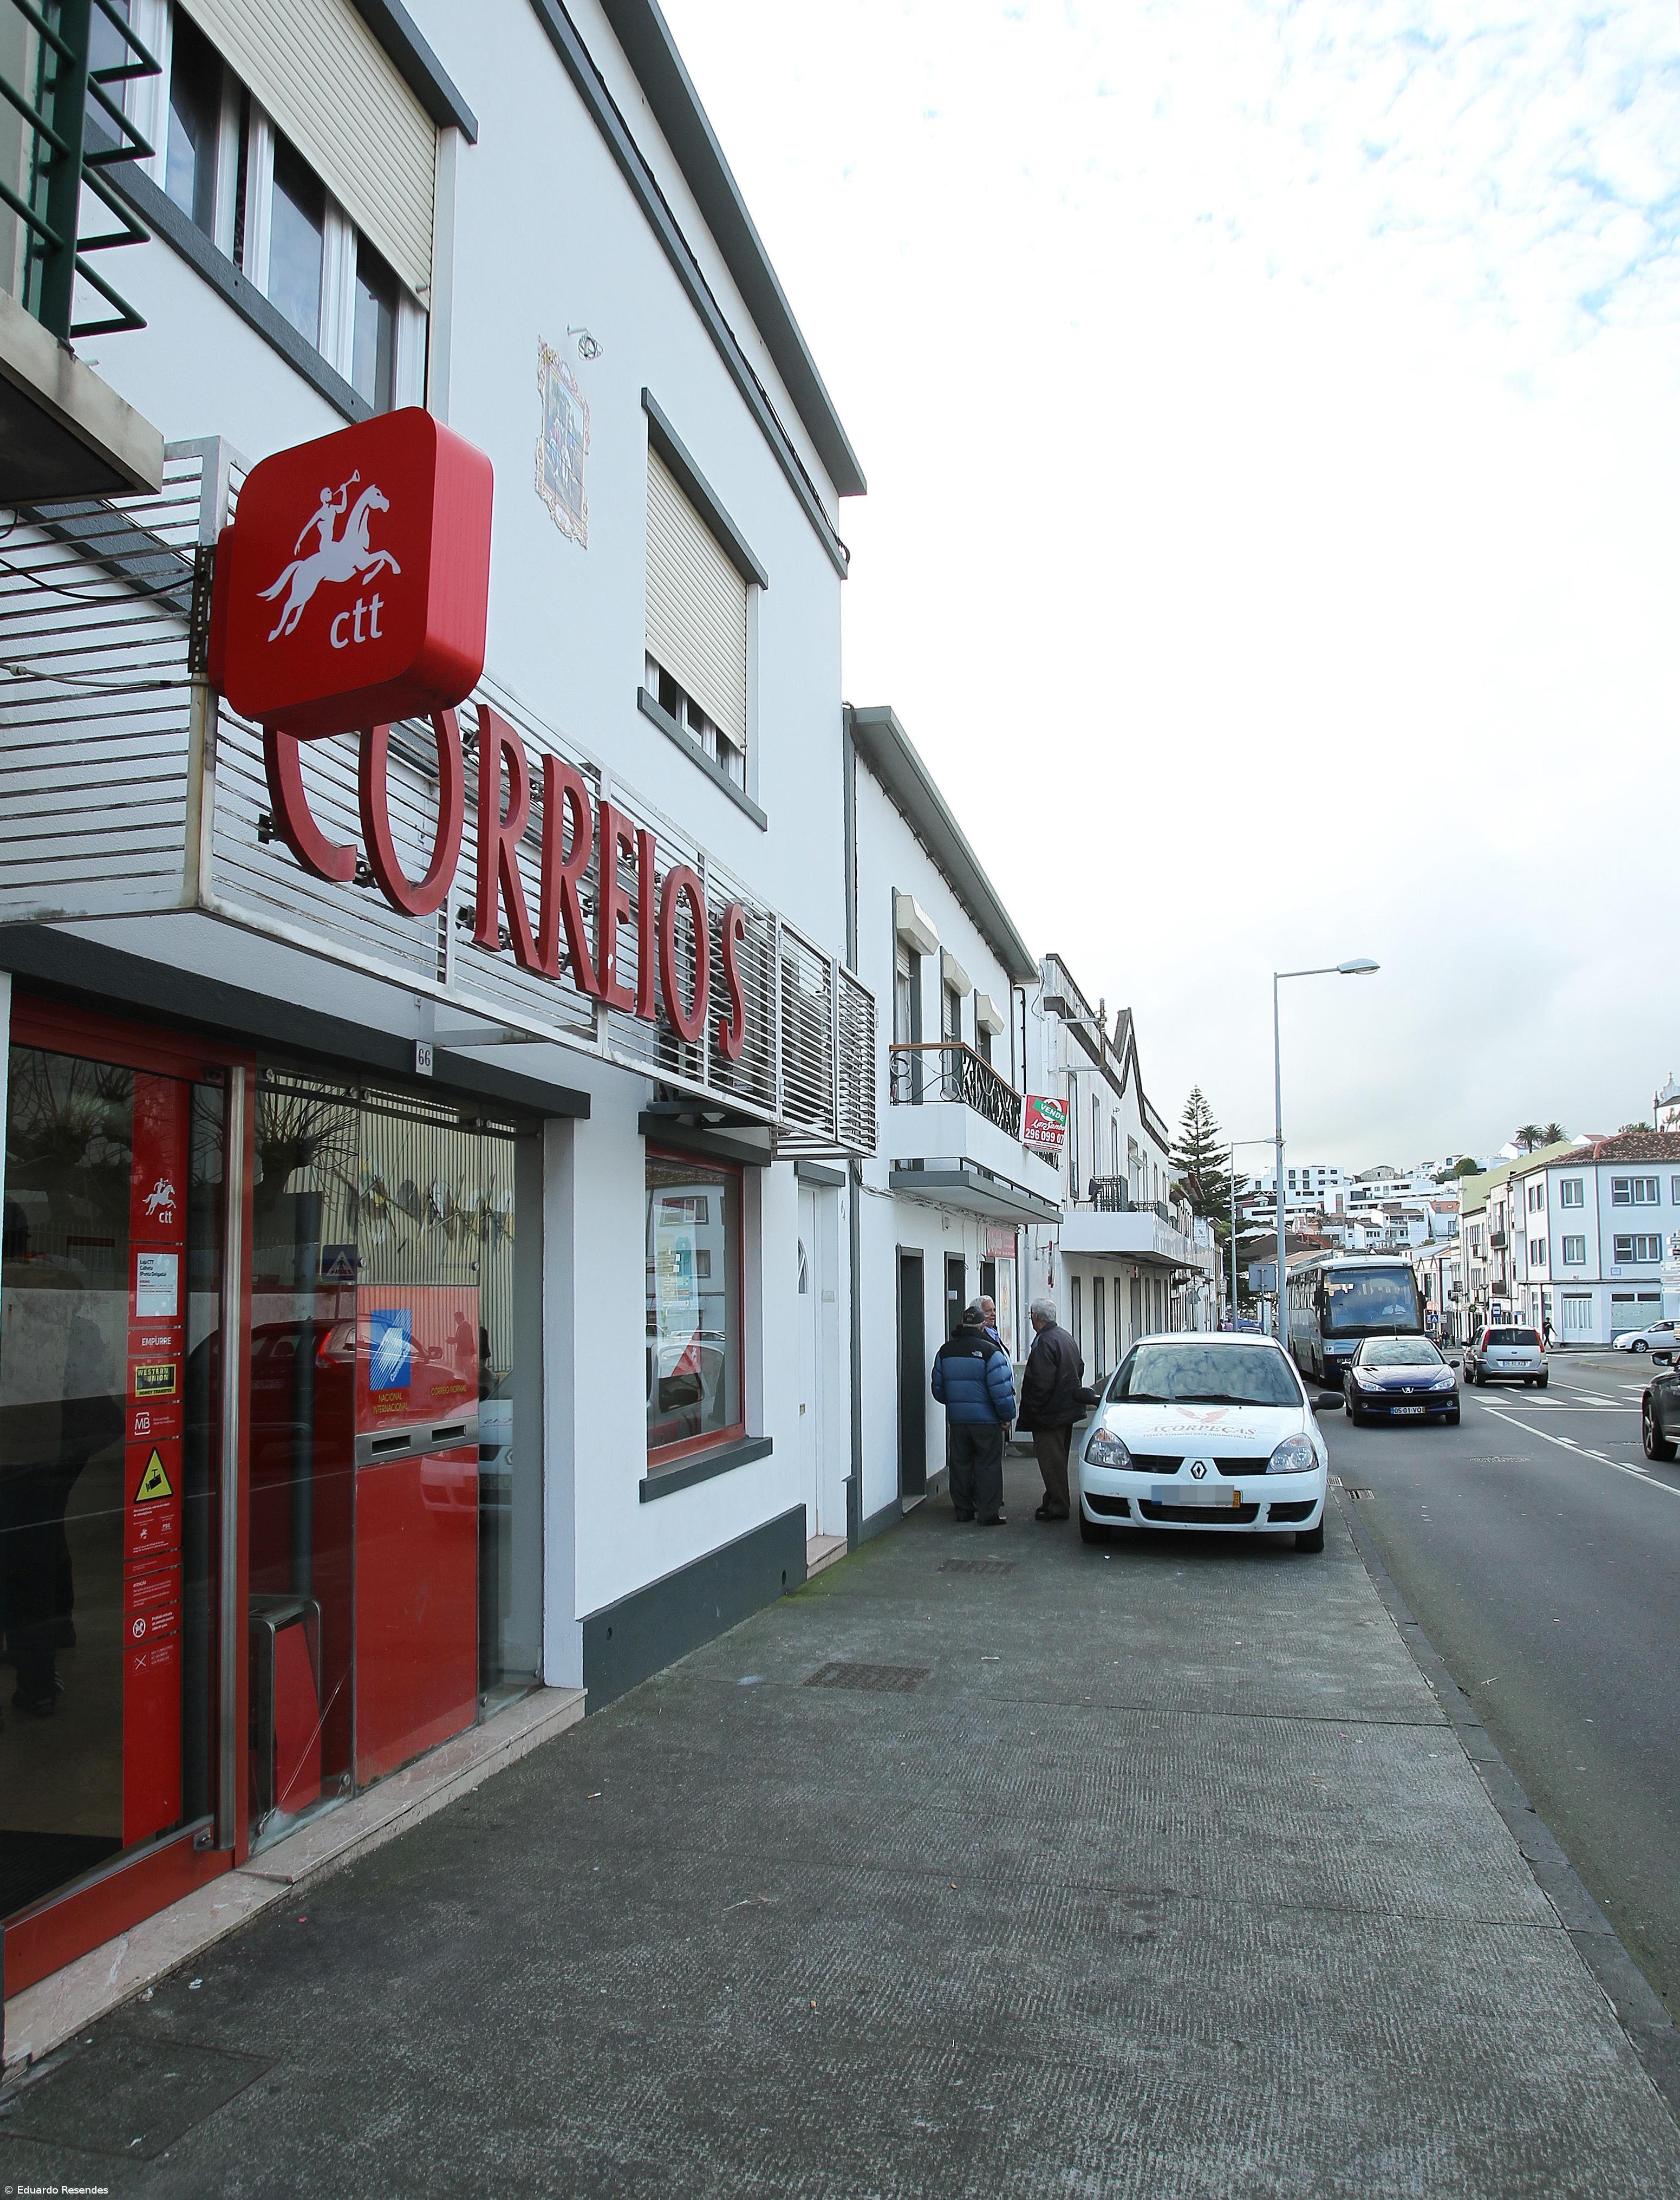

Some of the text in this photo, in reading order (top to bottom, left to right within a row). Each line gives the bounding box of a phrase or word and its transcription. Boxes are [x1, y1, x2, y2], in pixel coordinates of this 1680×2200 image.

[330, 593, 385, 649] ctt
[263, 704, 745, 1062] CORREIOS
[419, 1049, 431, 1066] 66
[1040, 1103, 1065, 1122] VENDE
[1025, 1128, 1040, 1140] 296
[1041, 1130, 1056, 1142] 099
[159, 1211, 173, 1223] ctt
[141, 1337, 172, 1347] EMPURRE
[138, 1368, 168, 1376] WESTERN
[147, 1374, 168, 1382] UNION
[431, 1384, 466, 1396] CORREIO NORMAL
[379, 1392, 402, 1403] NACIONAL
[373, 1403, 408, 1414] INTERNACIONAL
[135, 1417, 150, 1430] MB
